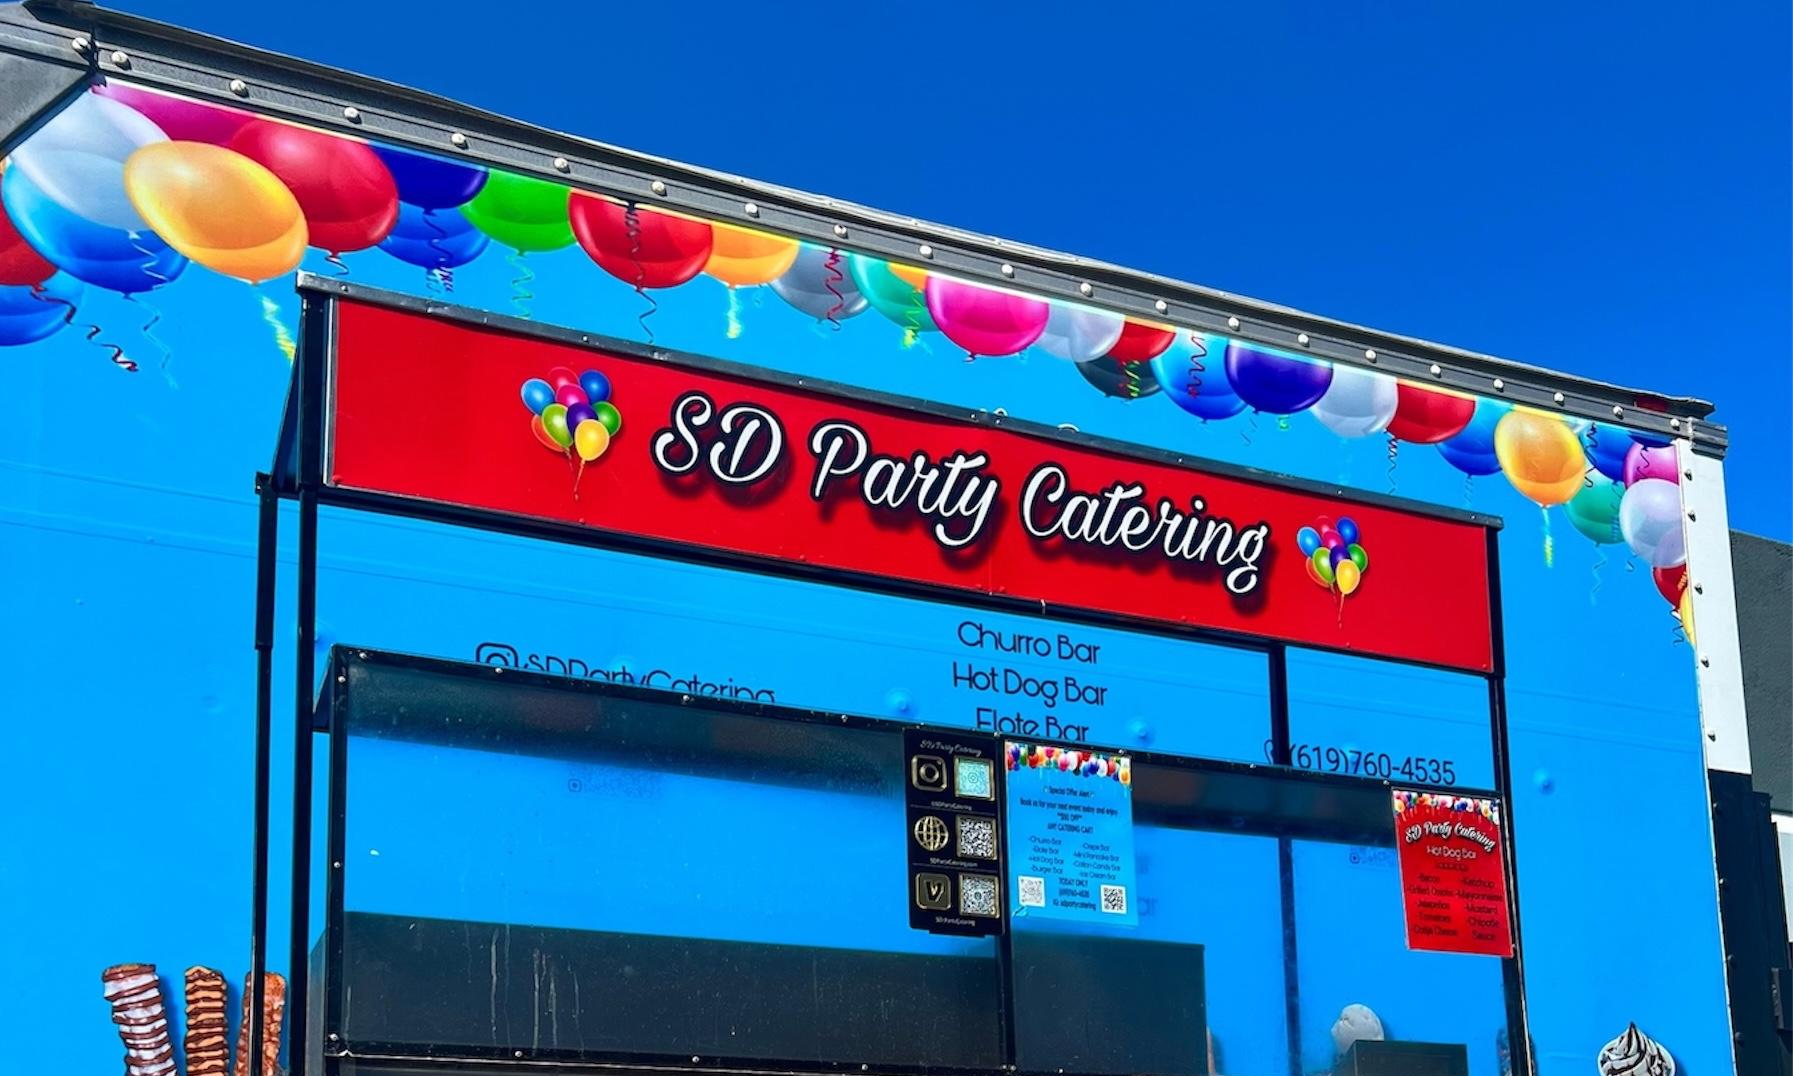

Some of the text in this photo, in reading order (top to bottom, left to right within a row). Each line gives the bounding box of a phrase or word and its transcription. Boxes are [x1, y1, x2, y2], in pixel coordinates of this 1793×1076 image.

[652, 393, 1272, 595] SD Party Catering
[958, 621, 1101, 664] Churro Bar
[953, 661, 1108, 708] Hot Dog Bar
[1045, 715, 1089, 742] Bar
[1290, 743, 1456, 785] (619)760-4535
[1406, 821, 1496, 852] SD Party Catering
[1426, 845, 1476, 861] Hot Dog Bar
